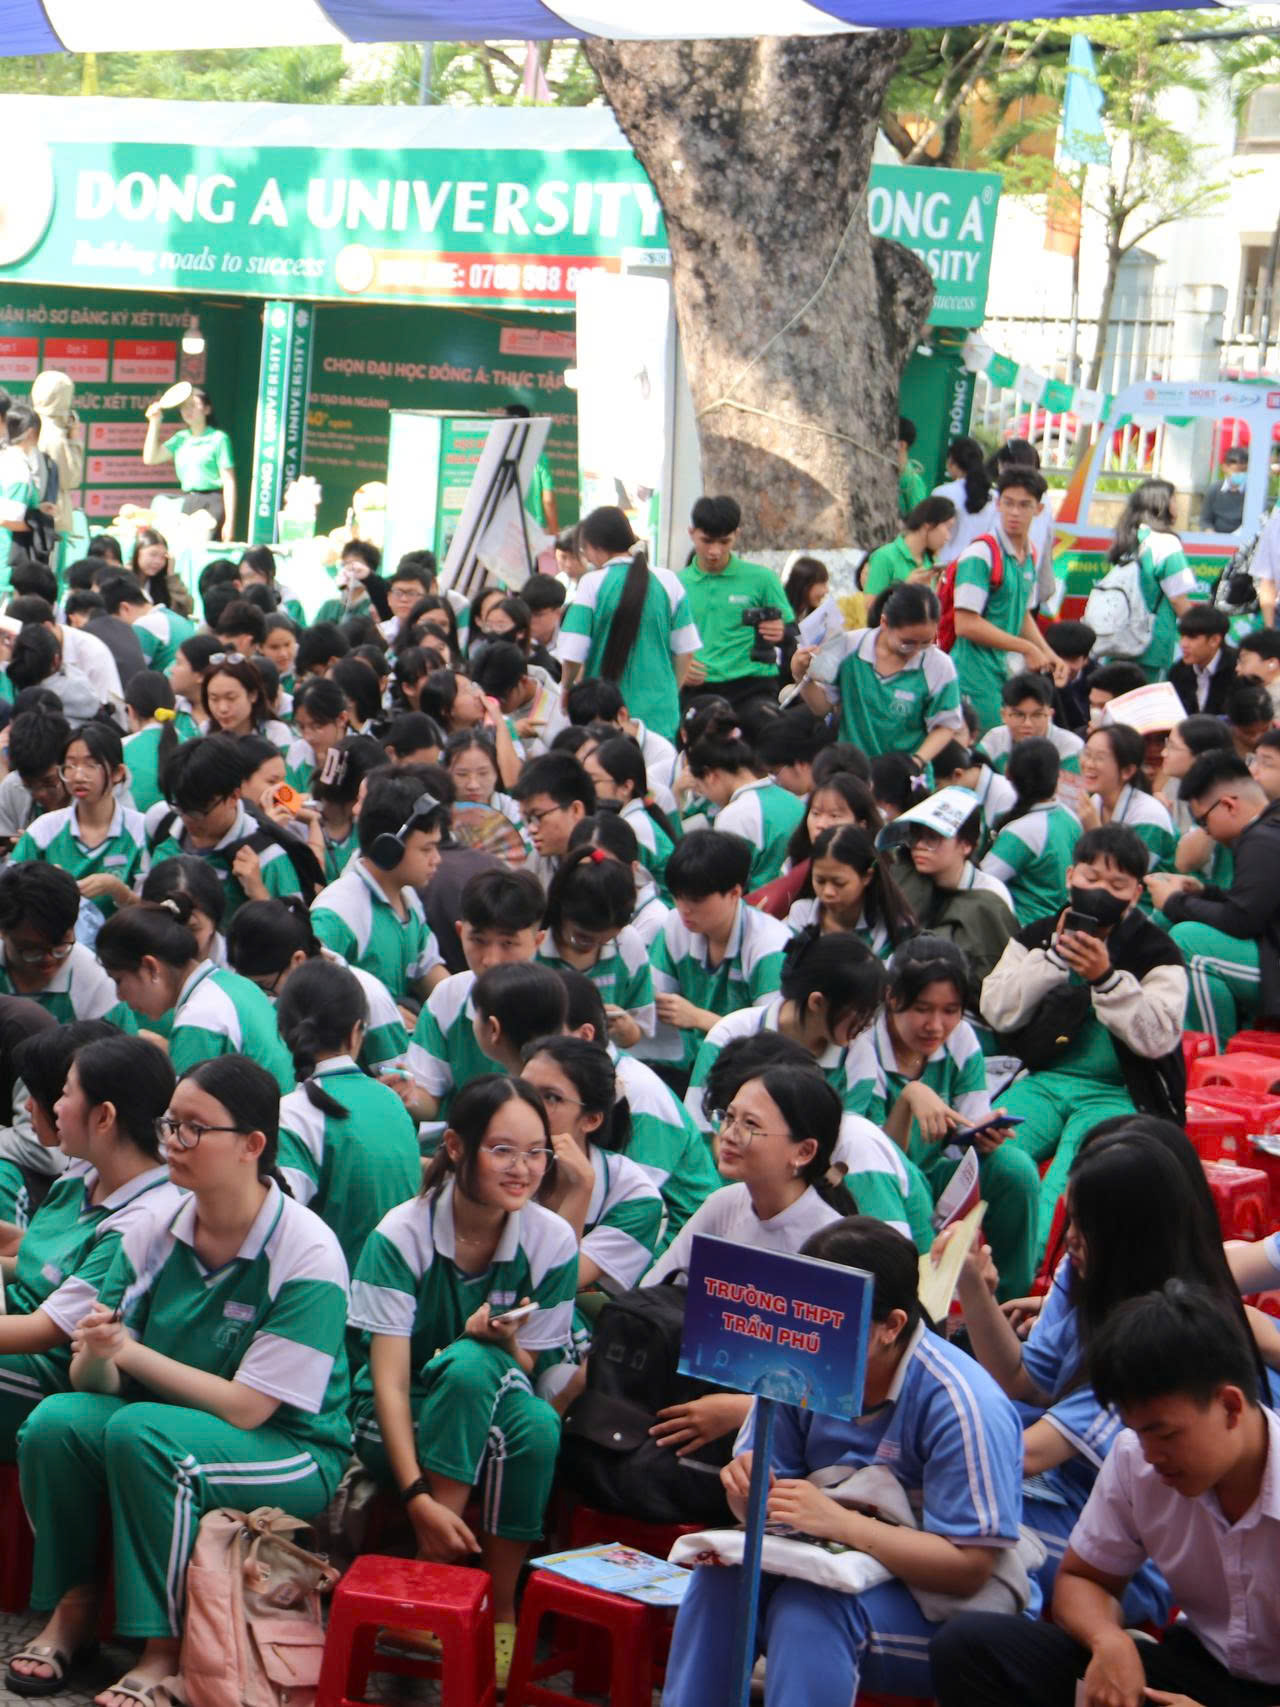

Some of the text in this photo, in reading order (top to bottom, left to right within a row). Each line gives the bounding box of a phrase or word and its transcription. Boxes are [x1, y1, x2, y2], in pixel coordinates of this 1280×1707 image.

[75, 169, 663, 238] DONG A UNIVERSITY
[160, 245, 217, 272] roads
[221, 251, 242, 272] to
[246, 253, 326, 278] success
[287, 335, 306, 443] UNIVERSITY
[323, 357, 368, 376] CHỌN
[367, 360, 392, 380] ĐẠI
[394, 362, 426, 383] HỌC
[428, 362, 472, 383] ĐÔNG
[493, 369, 534, 392] THỰC
[258, 334, 282, 518] DONG A UNIVERSITY
[703, 1276, 846, 1330] TRƯỜNG THPT
[721, 1310, 821, 1355] TRẦN PHÚ
